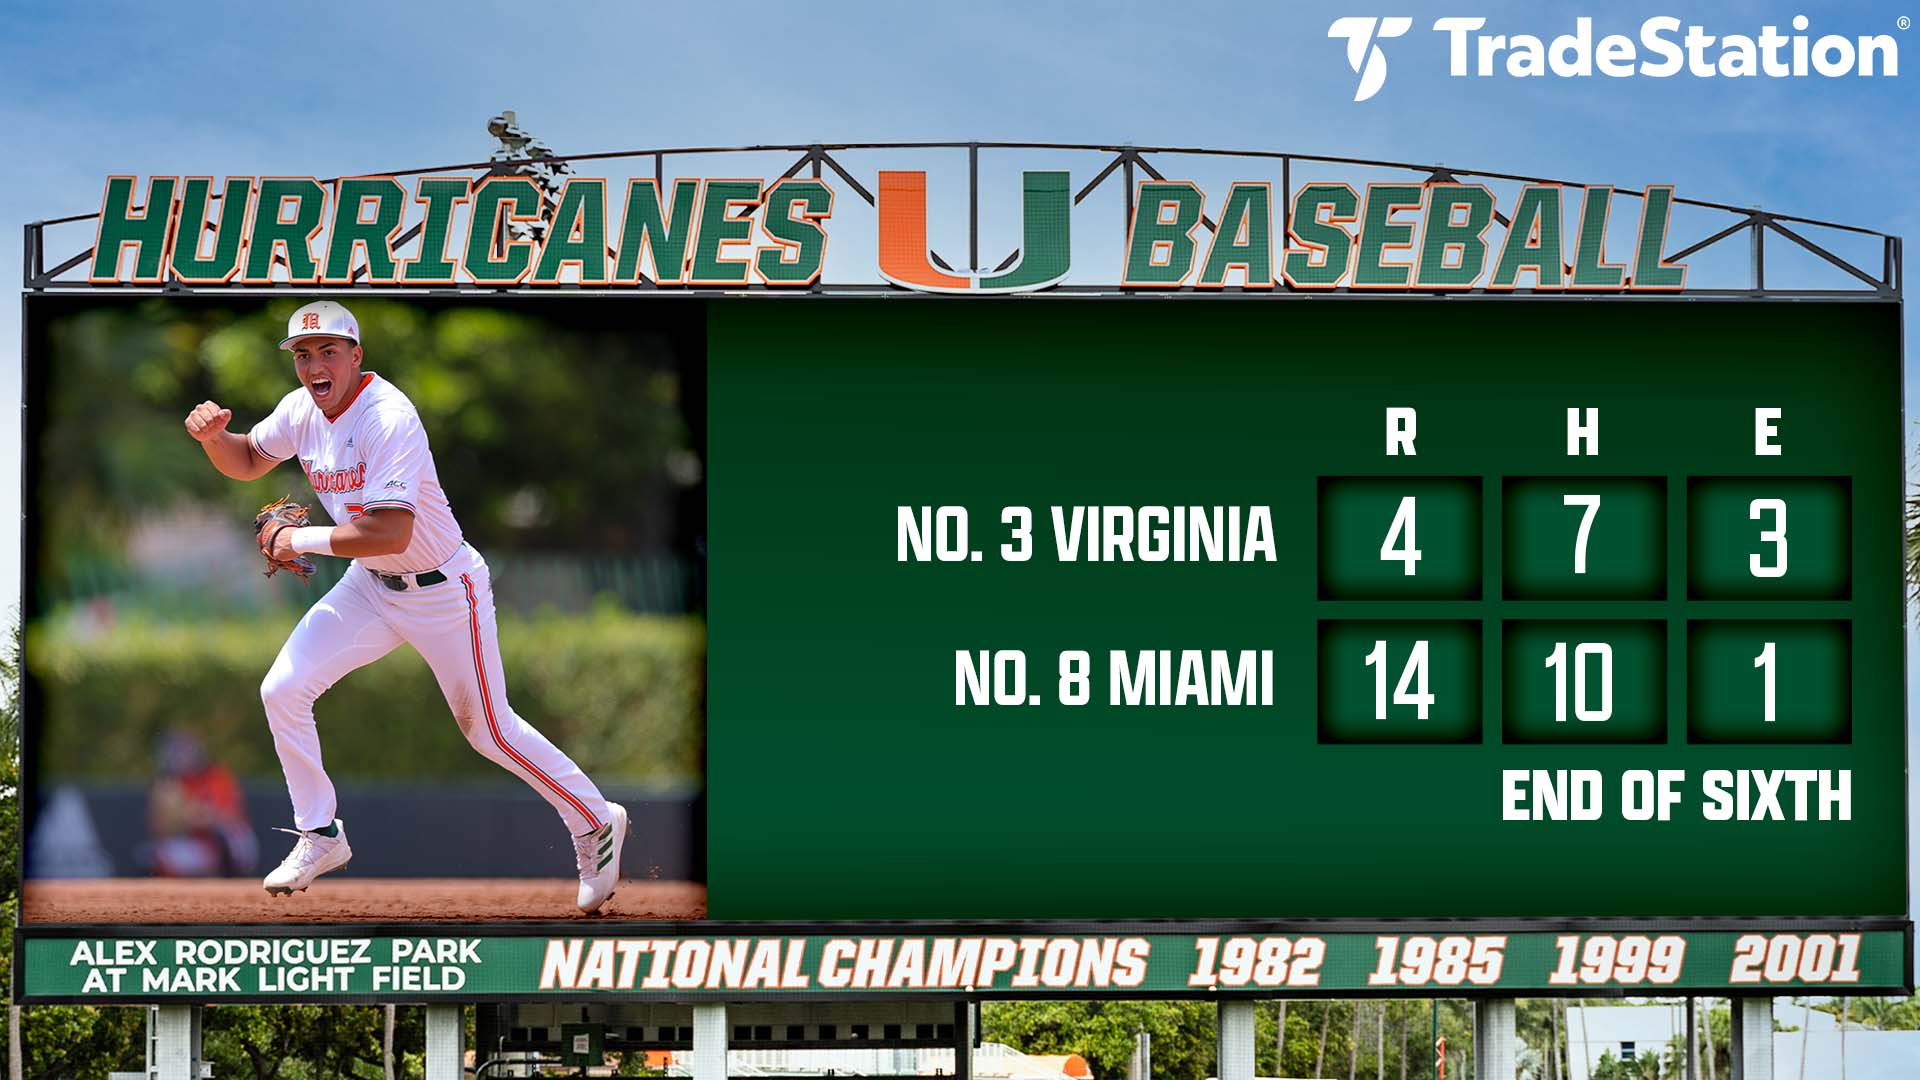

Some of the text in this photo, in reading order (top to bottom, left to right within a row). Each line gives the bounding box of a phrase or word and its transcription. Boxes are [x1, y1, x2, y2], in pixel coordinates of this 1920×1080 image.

[88, 170, 1688, 294] HURRICANES U BASEBALL
[1386, 407, 1782, 456] R H E
[897, 505, 1277, 562] NO. 3 VIRGINIA
[1380, 496, 1422, 576] 4
[1563, 494, 1601, 574] 7
[1749, 498, 1788, 578] 3
[955, 649, 1273, 706] NO. 8 MIAMI
[1365, 640, 1435, 720] 14
[1545, 642, 1613, 722] 10
[1754, 642, 1776, 722] 1
[1502, 769, 1852, 821] END OF SIXTH
[70, 938, 482, 966] ALEX RODRIGUEZ PARK
[81, 965, 466, 993] AT MARK LIGHT FIELD
[538, 936, 1150, 990] NATIONAL CHAMPIONS
[1188, 936, 1326, 986] 1982
[1368, 936, 1507, 985] 1985
[1549, 934, 1687, 984] 1999
[1730, 934, 1861, 983] 2001
